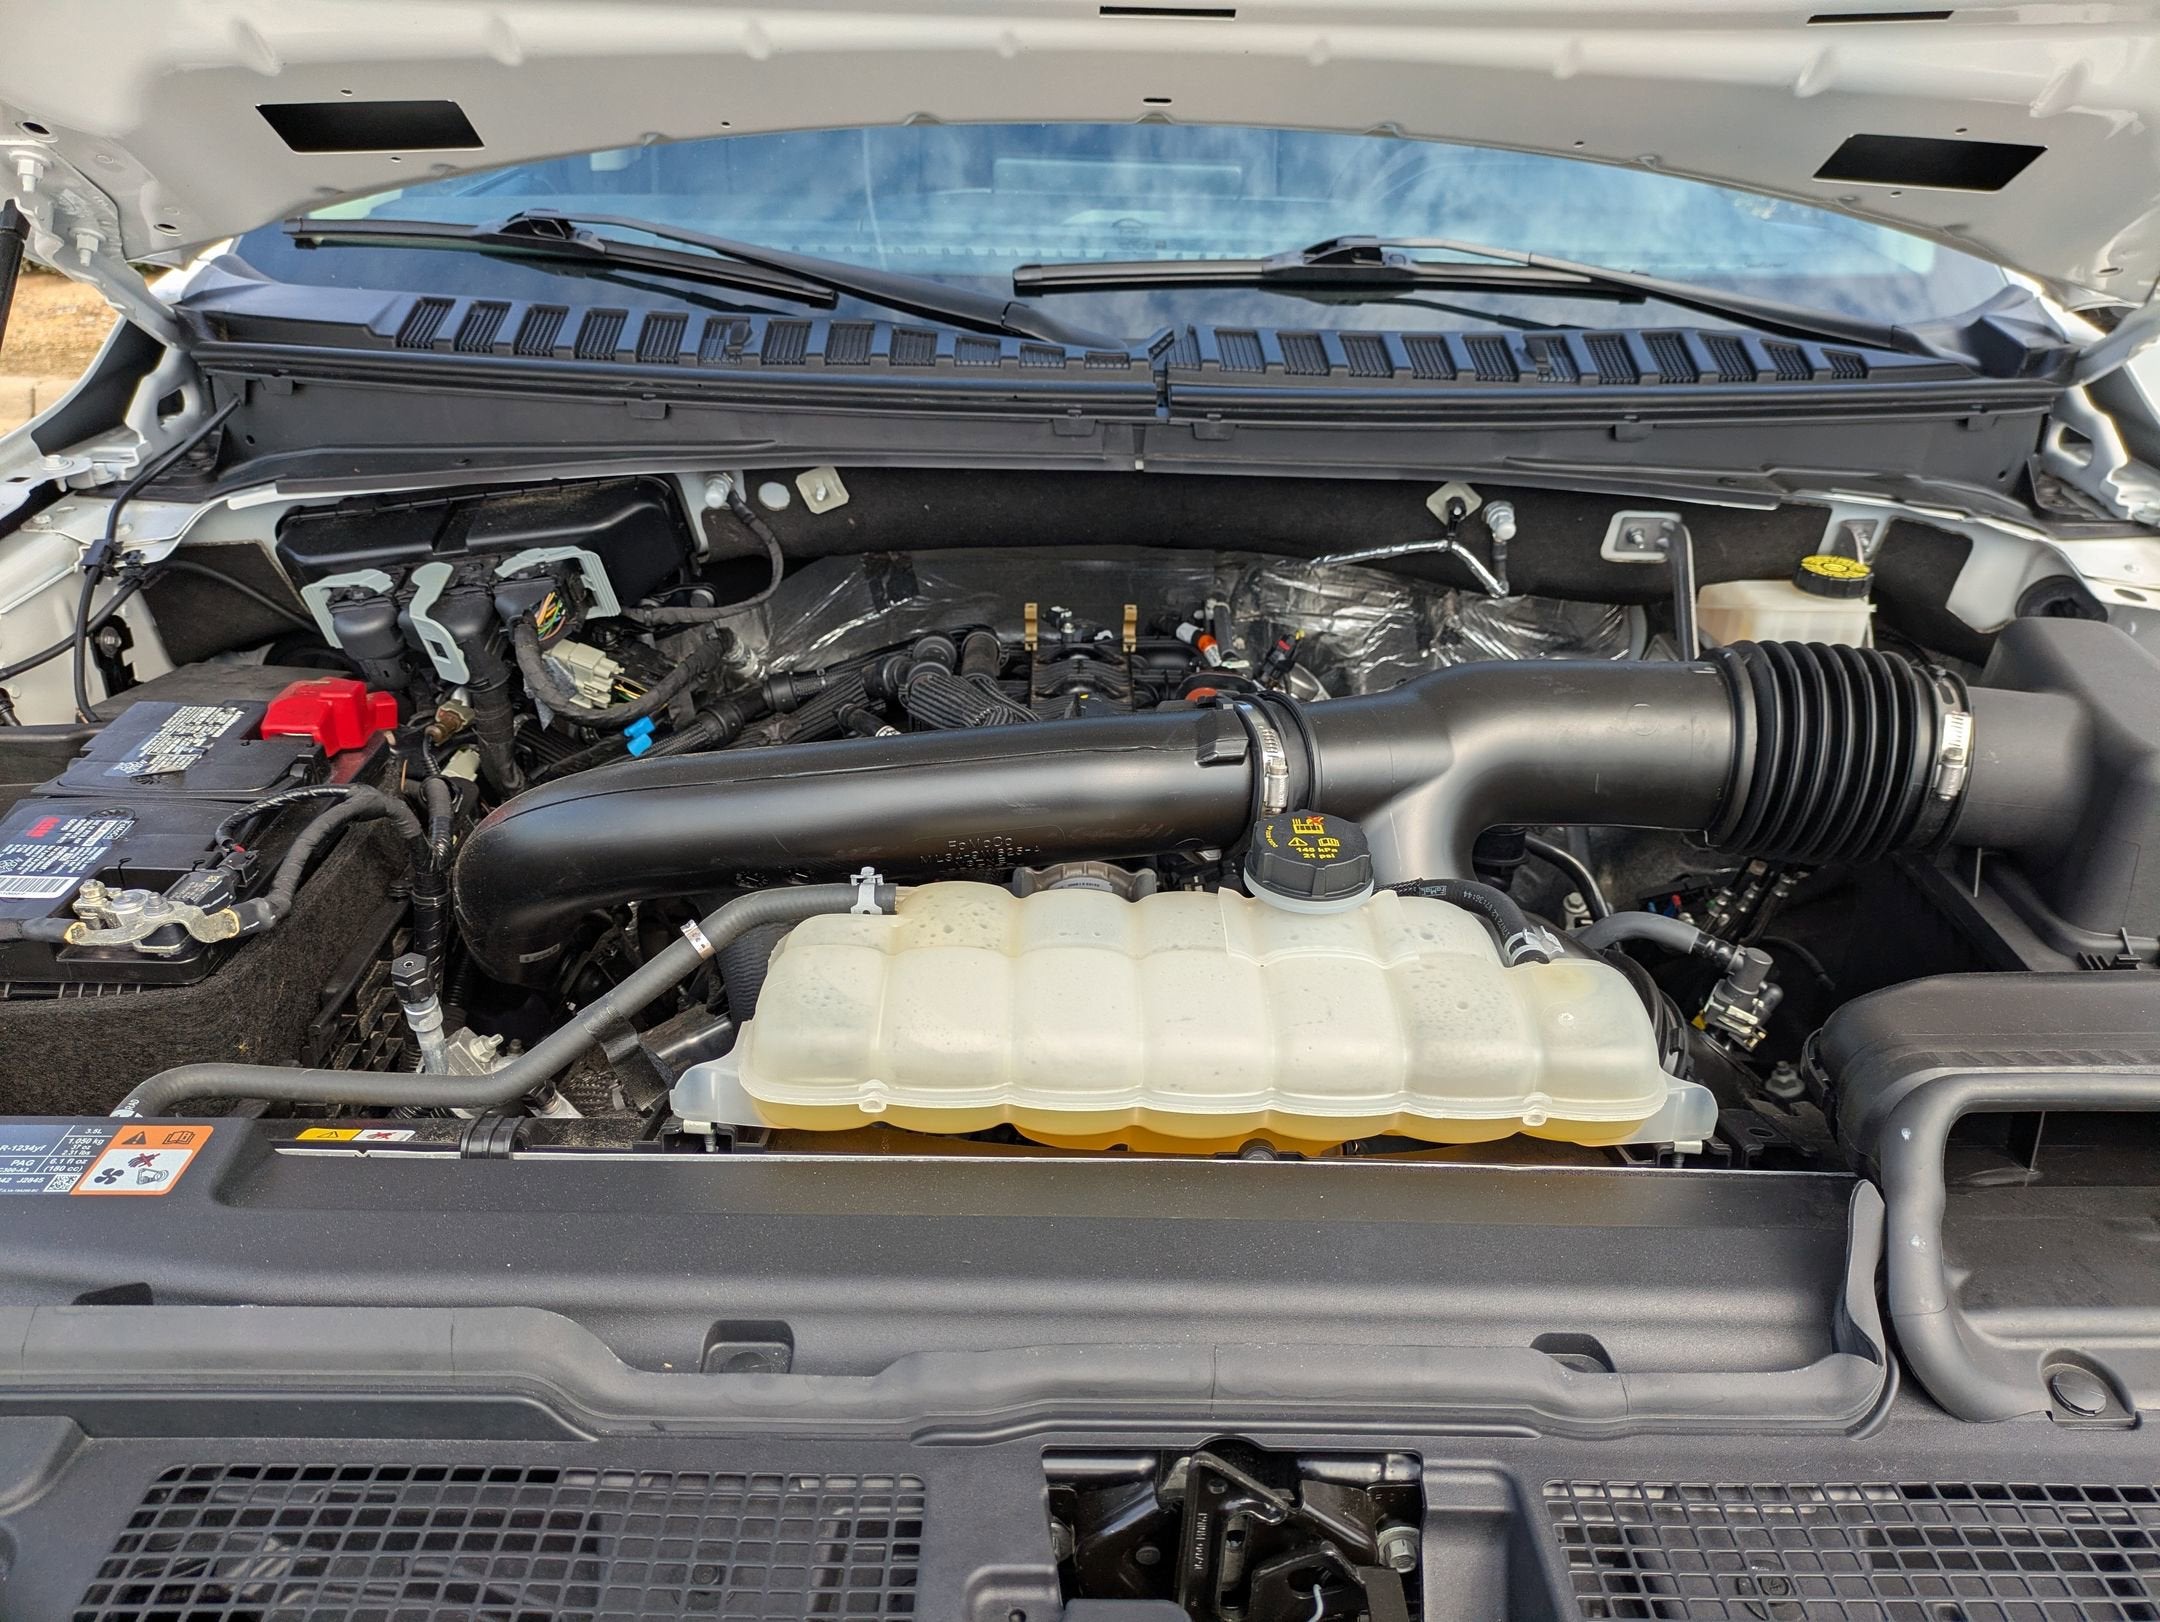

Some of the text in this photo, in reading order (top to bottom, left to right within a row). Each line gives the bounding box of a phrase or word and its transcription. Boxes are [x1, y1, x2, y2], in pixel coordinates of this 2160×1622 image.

[948, 836, 1013, 850] FoMoCo
[0, 1144, 47, 1152] R-1234yf
[10, 1159, 36, 1167] PAG
